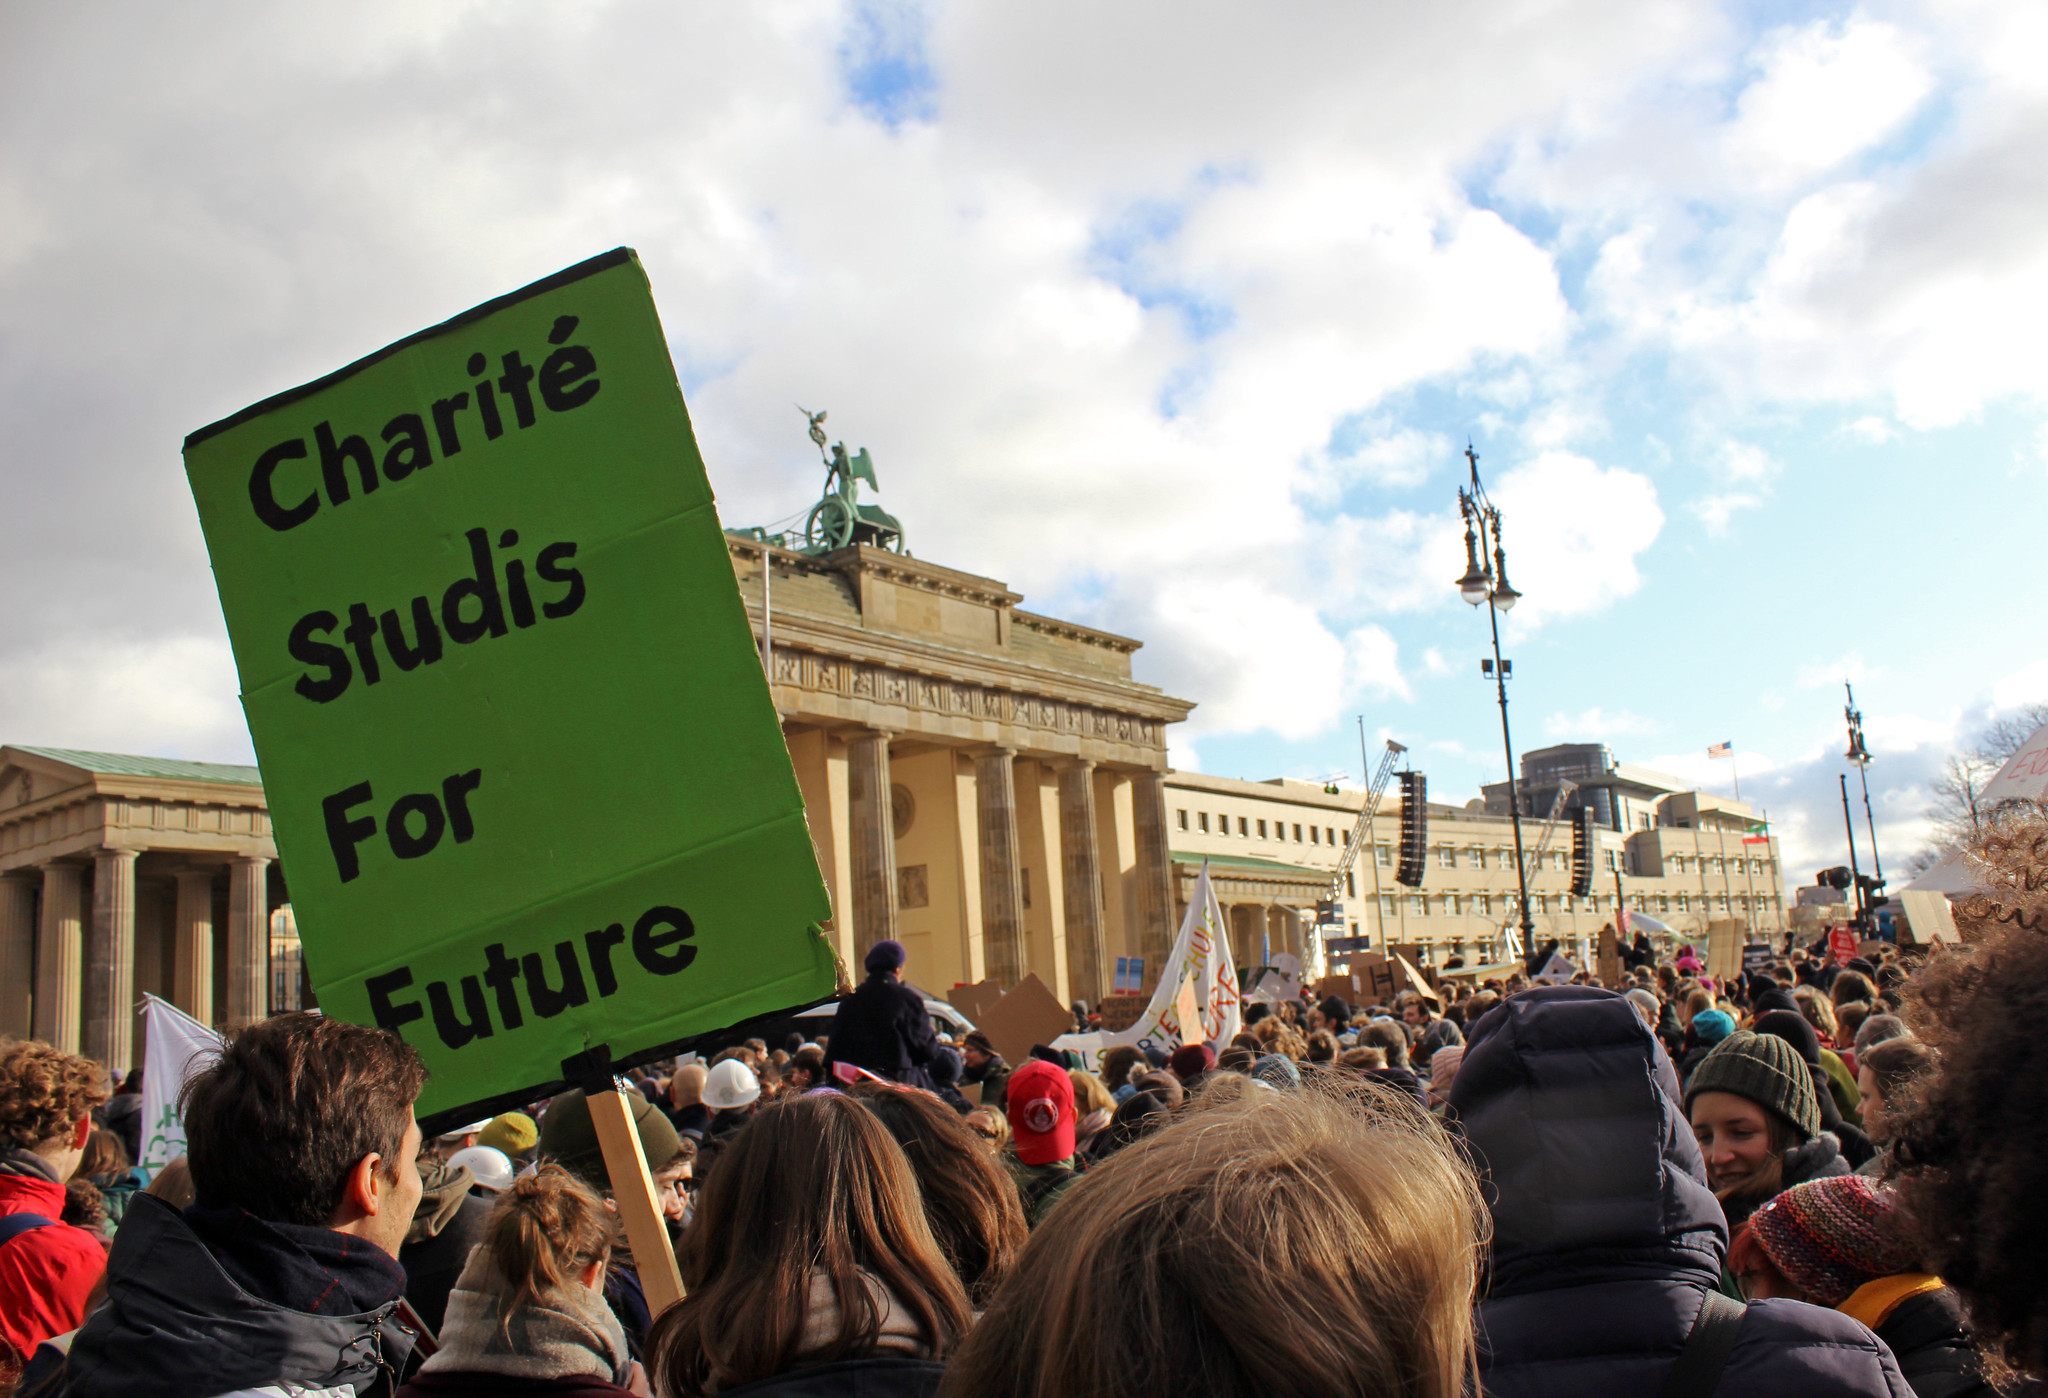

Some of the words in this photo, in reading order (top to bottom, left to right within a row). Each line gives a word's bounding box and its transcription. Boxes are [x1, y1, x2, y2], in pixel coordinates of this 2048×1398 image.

[246, 313, 602, 533] Charité
[286, 527, 588, 705] Studis
[320, 767, 482, 884] For
[364, 904, 699, 1051] Future
